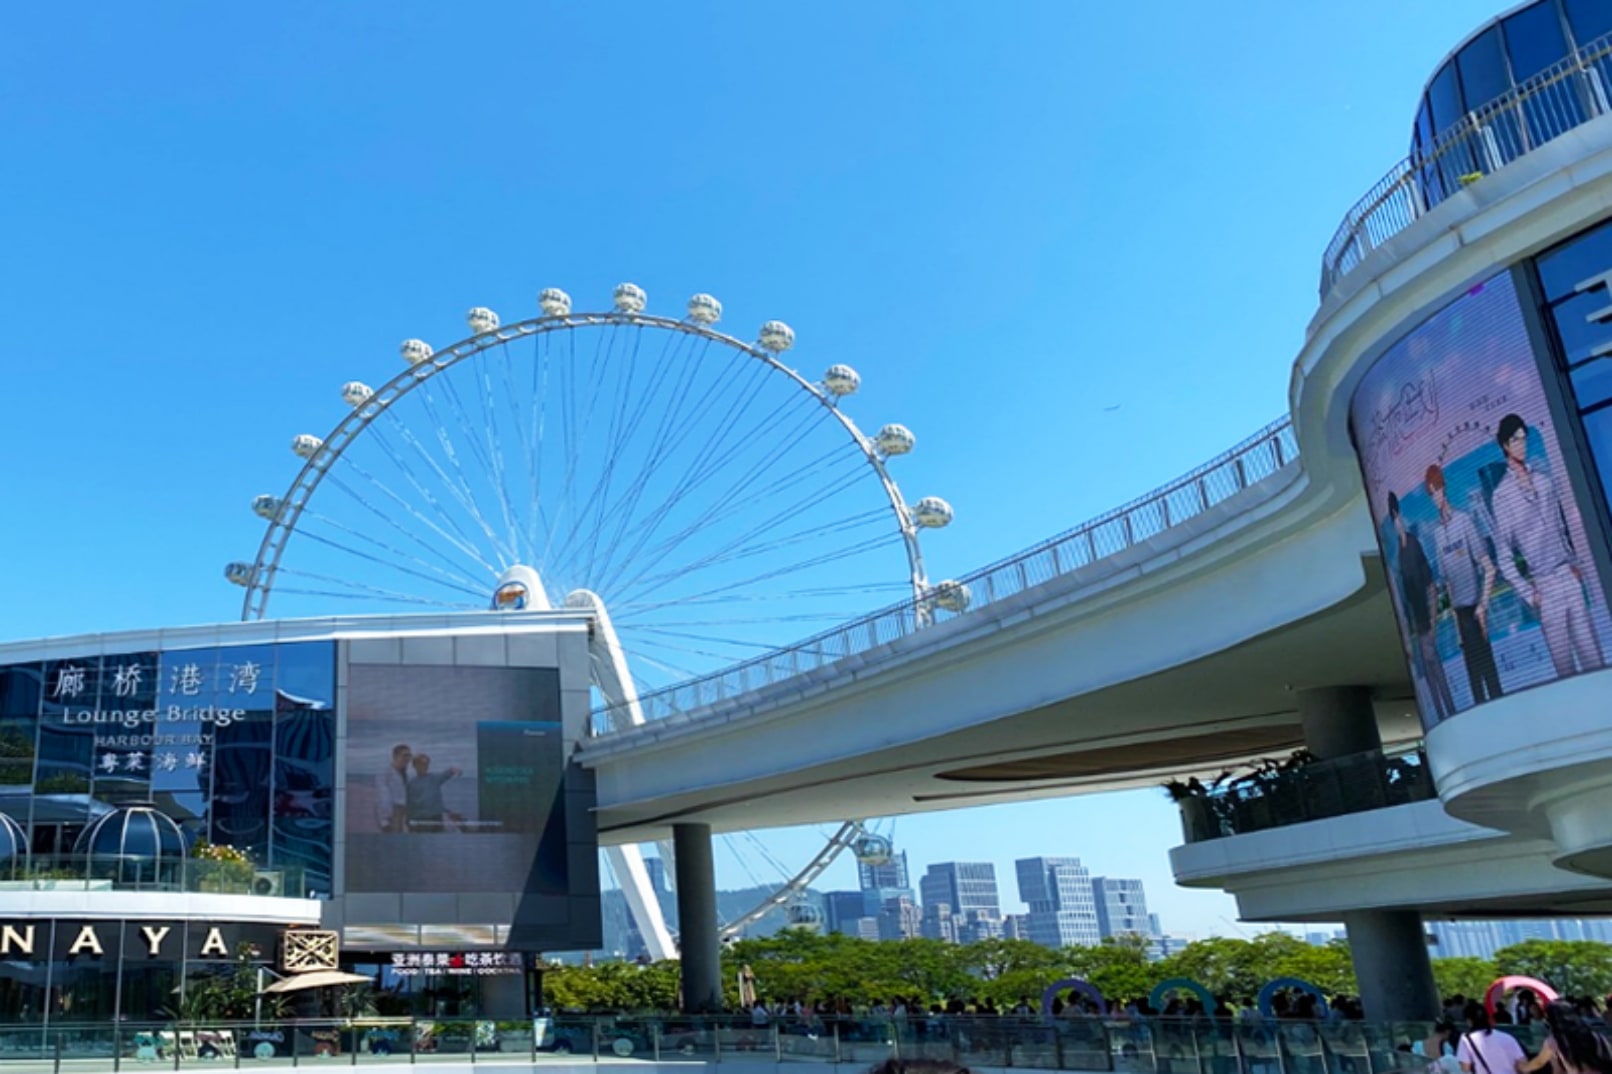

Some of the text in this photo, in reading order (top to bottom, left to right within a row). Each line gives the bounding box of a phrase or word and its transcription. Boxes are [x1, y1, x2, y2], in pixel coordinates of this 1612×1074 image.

[51, 660, 261, 698] 廊桥港湾
[63, 705, 246, 727] Lounge Bridge
[94, 734, 214, 747] HARBOUR BAY
[99, 751, 208, 774] 粤菜海鲜
[1, 924, 228, 955] NAYA
[391, 952, 449, 967] 亚洲泰菜
[391, 967, 418, 975] FOOD
[424, 967, 442, 975] TEA
[447, 967, 472, 975] WINE
